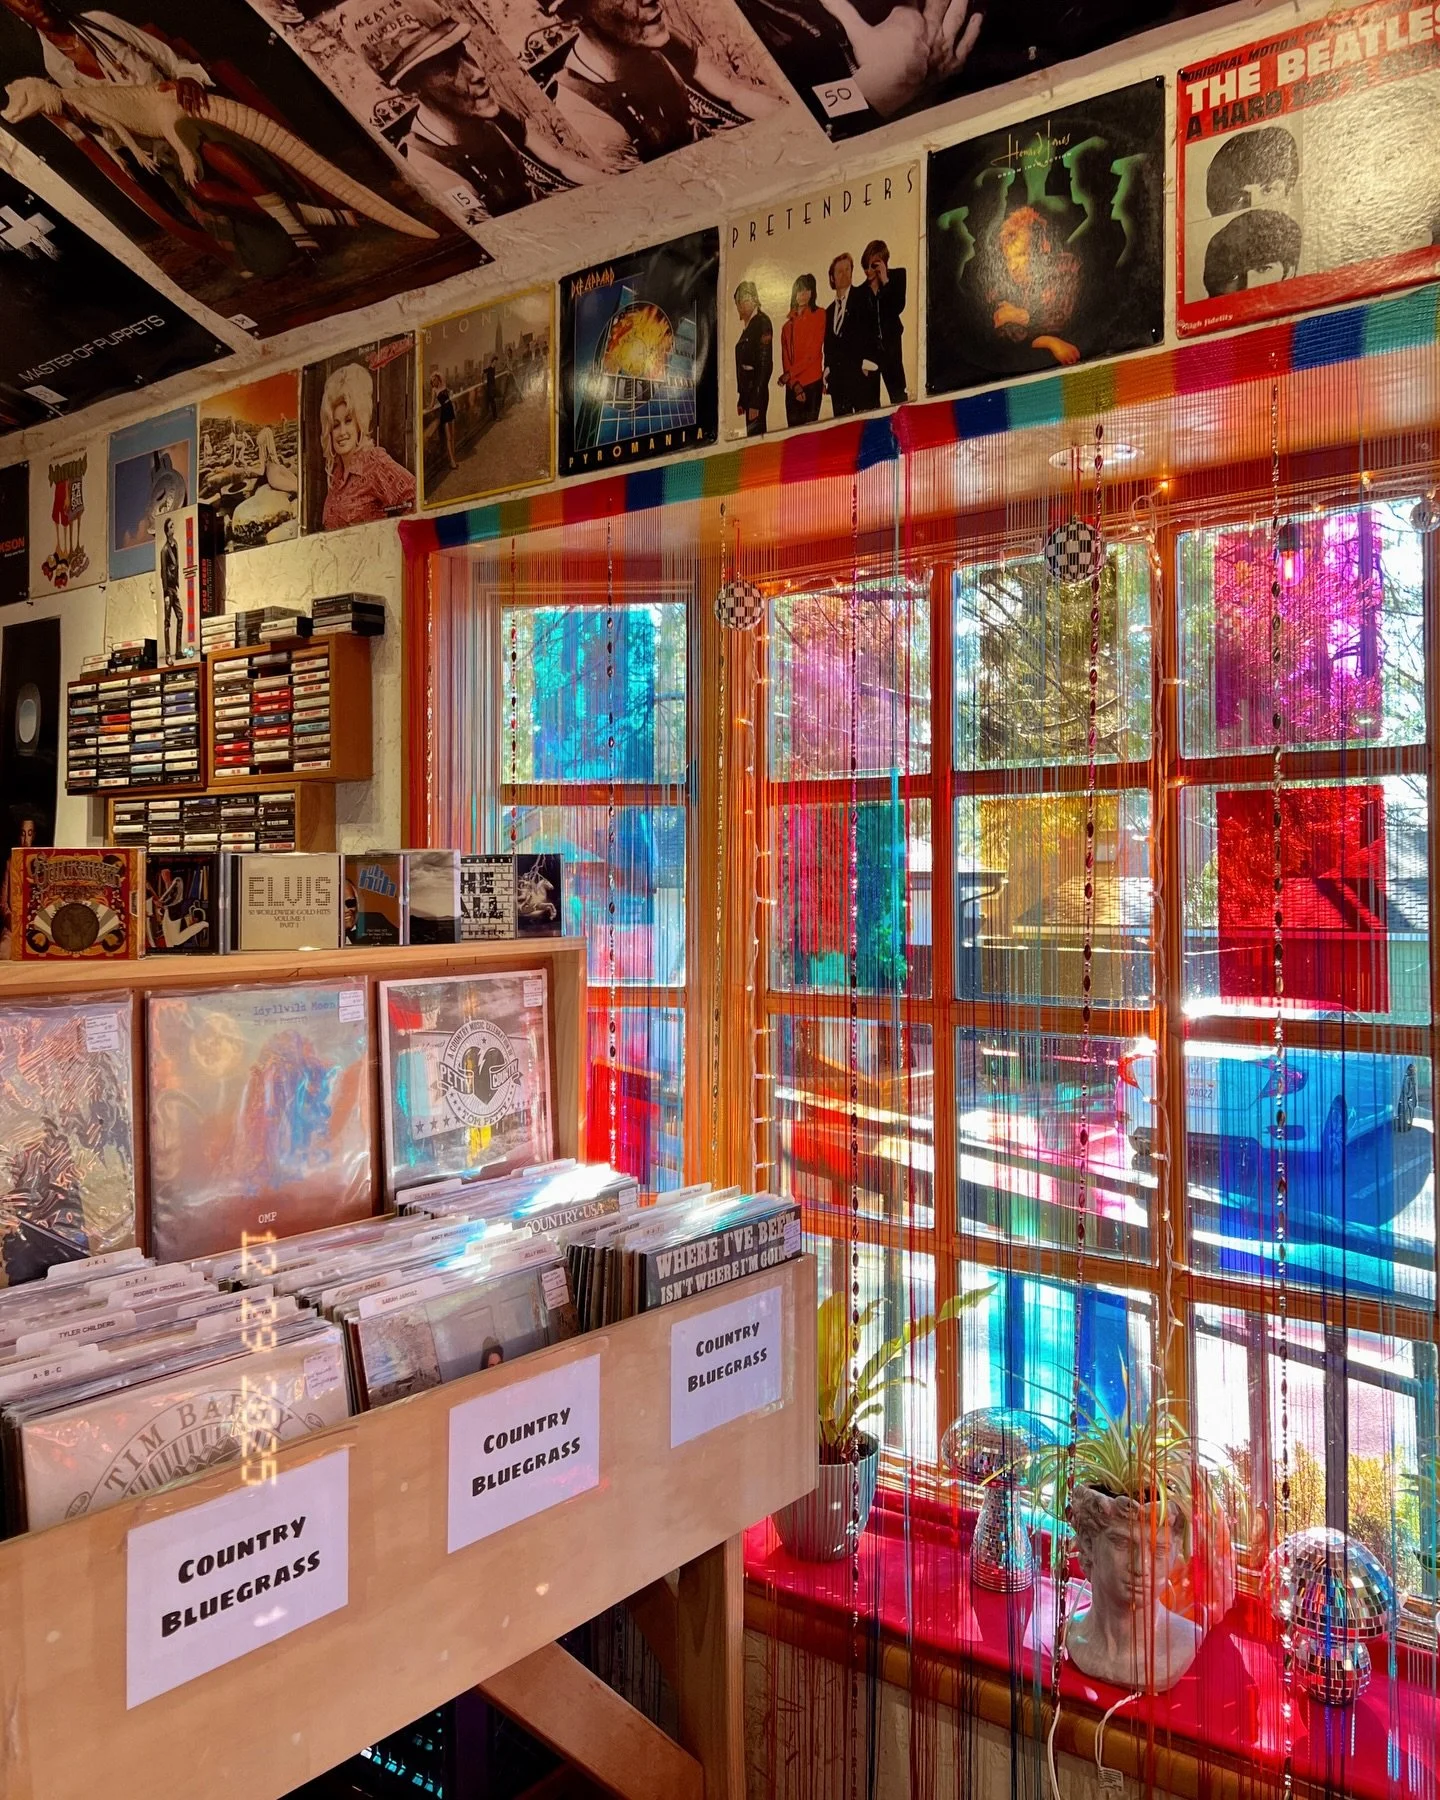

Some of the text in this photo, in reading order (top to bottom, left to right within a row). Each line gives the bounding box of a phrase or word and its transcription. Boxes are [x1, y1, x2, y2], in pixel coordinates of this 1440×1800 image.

[355, 0, 401, 31] MEAT IS
[367, 14, 413, 44] MURDER
[1187, 36, 1298, 81] ORIGINAL MOTION
[825, 88, 852, 107] 50
[1186, 61, 1260, 114] THE
[1187, 117, 1203, 140] A
[1213, 90, 1281, 131] HARD
[453, 191, 471, 207] 15
[732, 167, 916, 248] PRETENDERS
[571, 267, 615, 298] DEF LEPPARD
[1204, 314, 1233, 327] fidelity
[18, 315, 166, 383] MASTER OF PUPPETS
[569, 427, 703, 467] PYROMANIA
[72, 482, 81, 490] DE
[249, 876, 331, 907] ELVIS
[461, 872, 494, 894] HE
[461, 897, 504, 918] ALL
[311, 1001, 335, 1012] Moon
[452, 1026, 471, 1053] COUNTRY
[469, 1021, 485, 1031] MUSIC
[486, 1022, 510, 1049] CELEBRATION
[441, 1060, 519, 1094] PETTY COUNTRY
[461, 1104, 508, 1125] TOM PETTY
[258, 1211, 277, 1224] OMP
[526, 1208, 578, 1234] COUNTRY
[583, 1202, 605, 1218] USA
[431, 1233, 443, 1241] KACY
[656, 1236, 718, 1280] WHERE
[723, 1225, 753, 1257] I'VE
[758, 1211, 796, 1246] BEEN
[525, 1251, 536, 1259] JELLY
[133, 1281, 186, 1298] RODNEY CROWELL
[661, 1244, 793, 1305] ISN'T WHERE I'M GOIN
[382, 1296, 398, 1305] SARAH
[59, 1320, 115, 1339] TYLER CHILDERS
[696, 1321, 760, 1357] COUNTRY
[687, 1347, 767, 1393] BLUEGRASS
[483, 1407, 571, 1454] COUNTRY
[104, 1423, 165, 1492] TIM
[472, 1437, 580, 1497] BLUEGRASS
[178, 1516, 306, 1584] COUNTRY
[161, 1550, 320, 1638] BLUEGRASS
